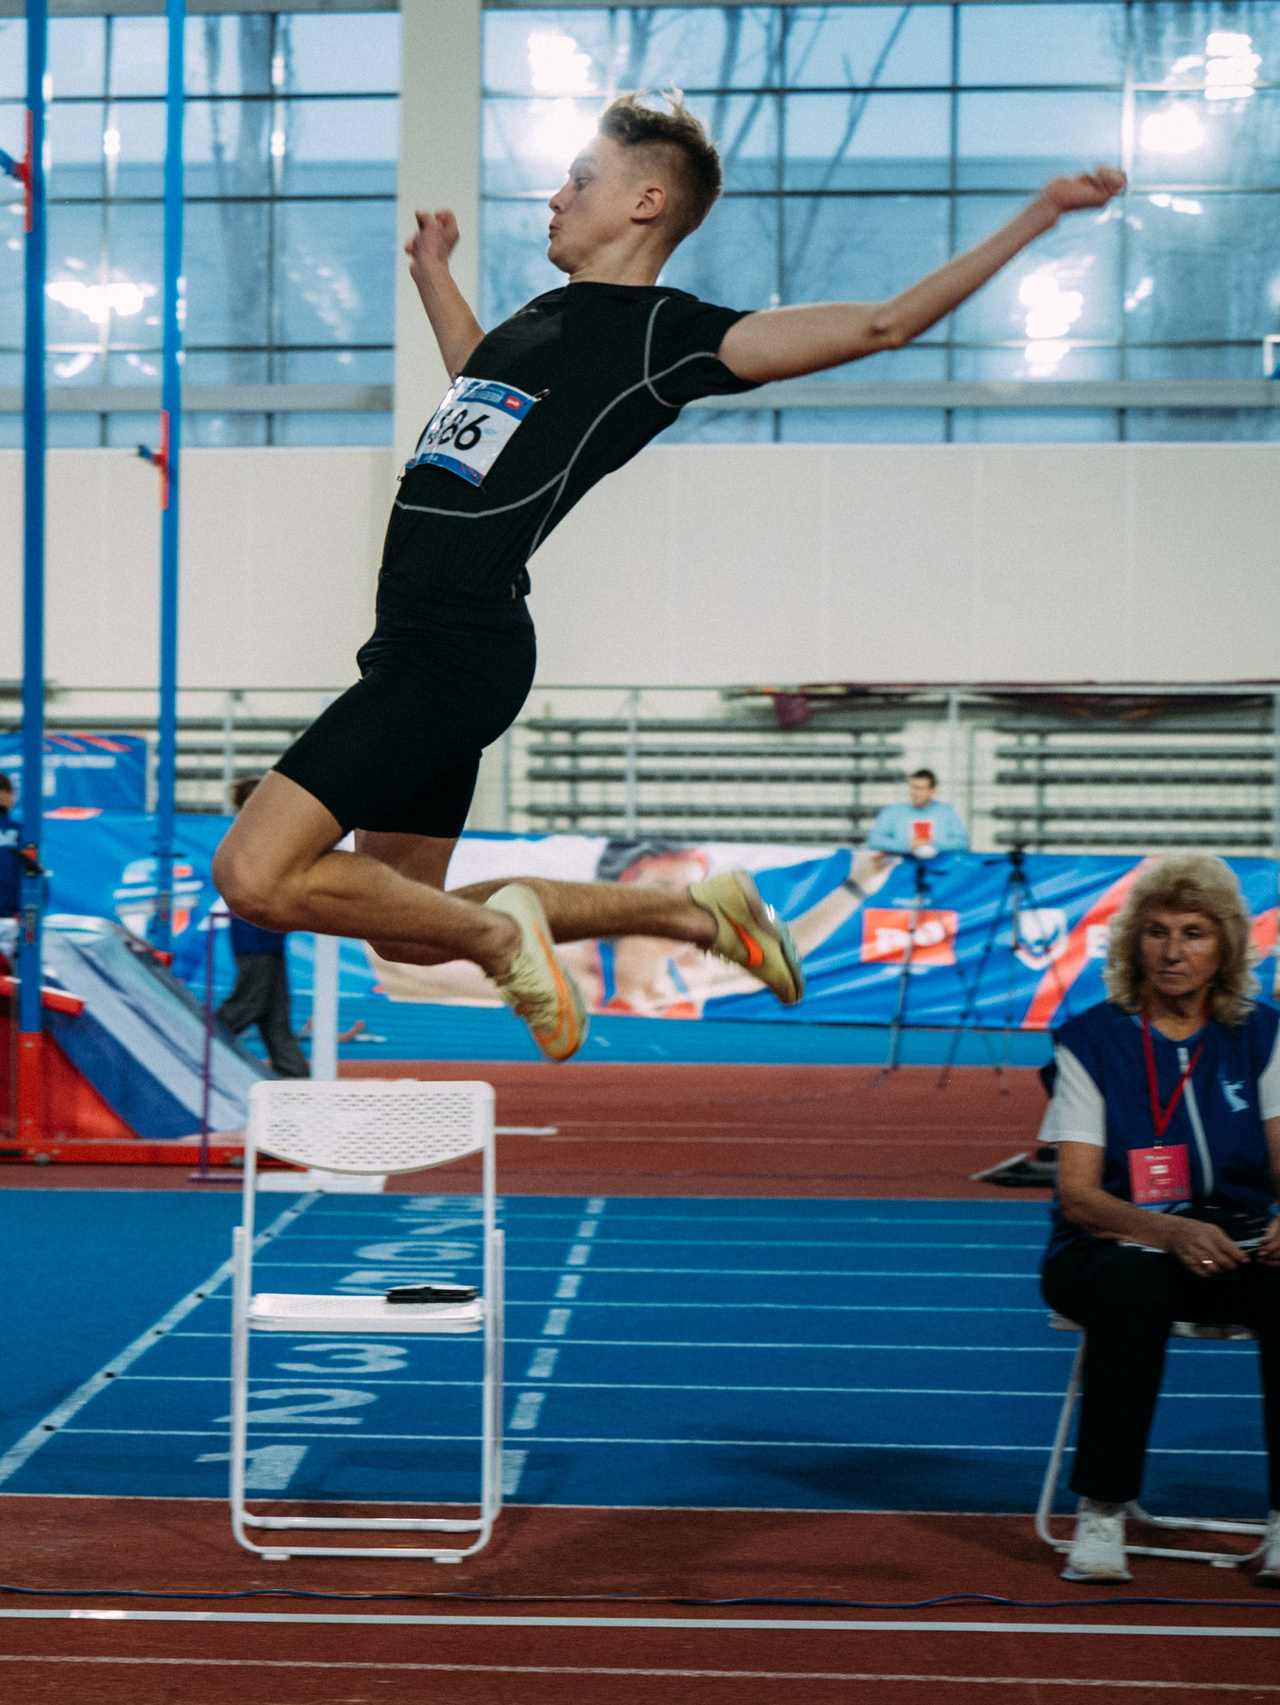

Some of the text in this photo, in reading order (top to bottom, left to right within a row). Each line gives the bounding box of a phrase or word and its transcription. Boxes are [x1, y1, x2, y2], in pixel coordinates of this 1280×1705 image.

[353, 1241, 480, 1262] 6
[274, 1343, 409, 1374] 3
[212, 1387, 380, 1425] 2
[194, 1444, 311, 1490] 1
